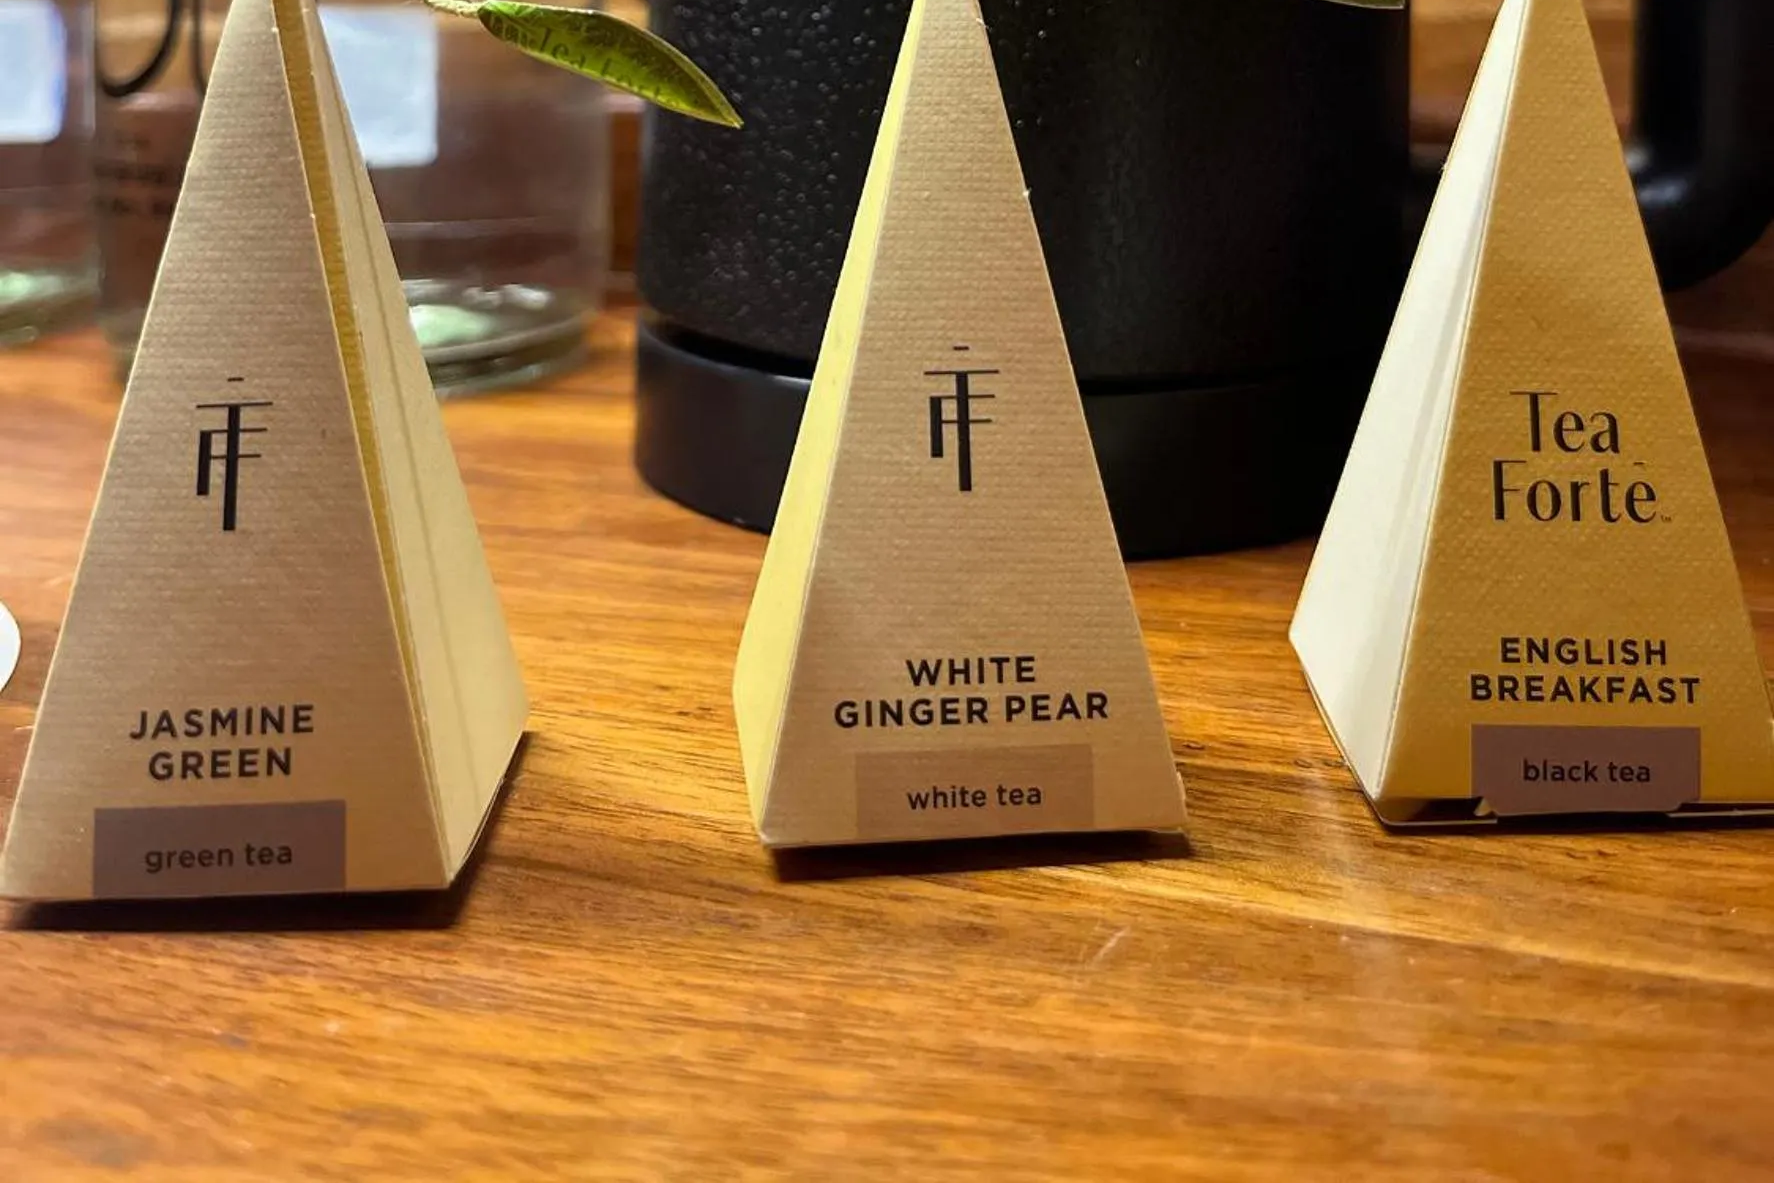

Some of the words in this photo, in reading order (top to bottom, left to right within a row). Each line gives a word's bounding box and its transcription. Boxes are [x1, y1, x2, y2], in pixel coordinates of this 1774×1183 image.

[1509, 390, 1621, 455] Tea
[1500, 636, 1668, 666] ENGLISH
[905, 655, 1036, 686] WHITE
[1470, 674, 1700, 704] BREAKFAST
[129, 704, 315, 740] JASMINE
[834, 697, 989, 729] GINGER
[1005, 692, 1109, 723] PEAR
[148, 747, 292, 781] GREEN
[1522, 758, 1598, 783] black
[1607, 761, 1651, 784] tea
[906, 785, 987, 811] white
[996, 783, 1042, 806] tea
[144, 847, 235, 874] green
[244, 843, 293, 867] tea
